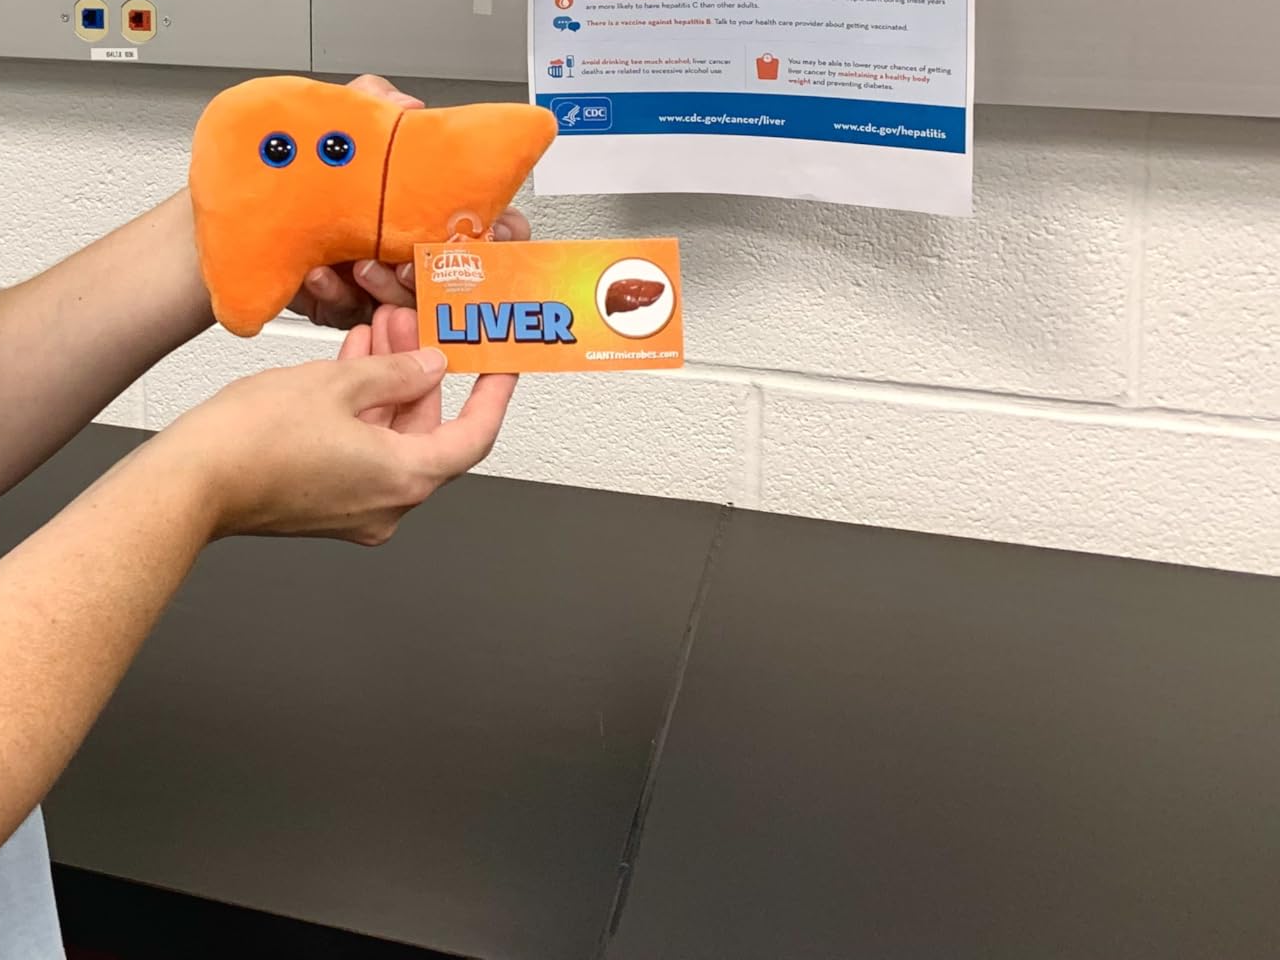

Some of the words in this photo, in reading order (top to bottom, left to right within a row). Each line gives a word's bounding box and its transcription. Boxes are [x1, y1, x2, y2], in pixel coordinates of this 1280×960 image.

[584, 108, 606, 118] CDC
[658, 113, 786, 126] www.cdc.gov/cancer/liver
[833, 122, 946, 140] www.cdc.gov/hepatitis
[434, 255, 480, 270] GIANT
[436, 301, 577, 344] LIVER
[585, 350, 679, 360] GIANTmicrobes.com
